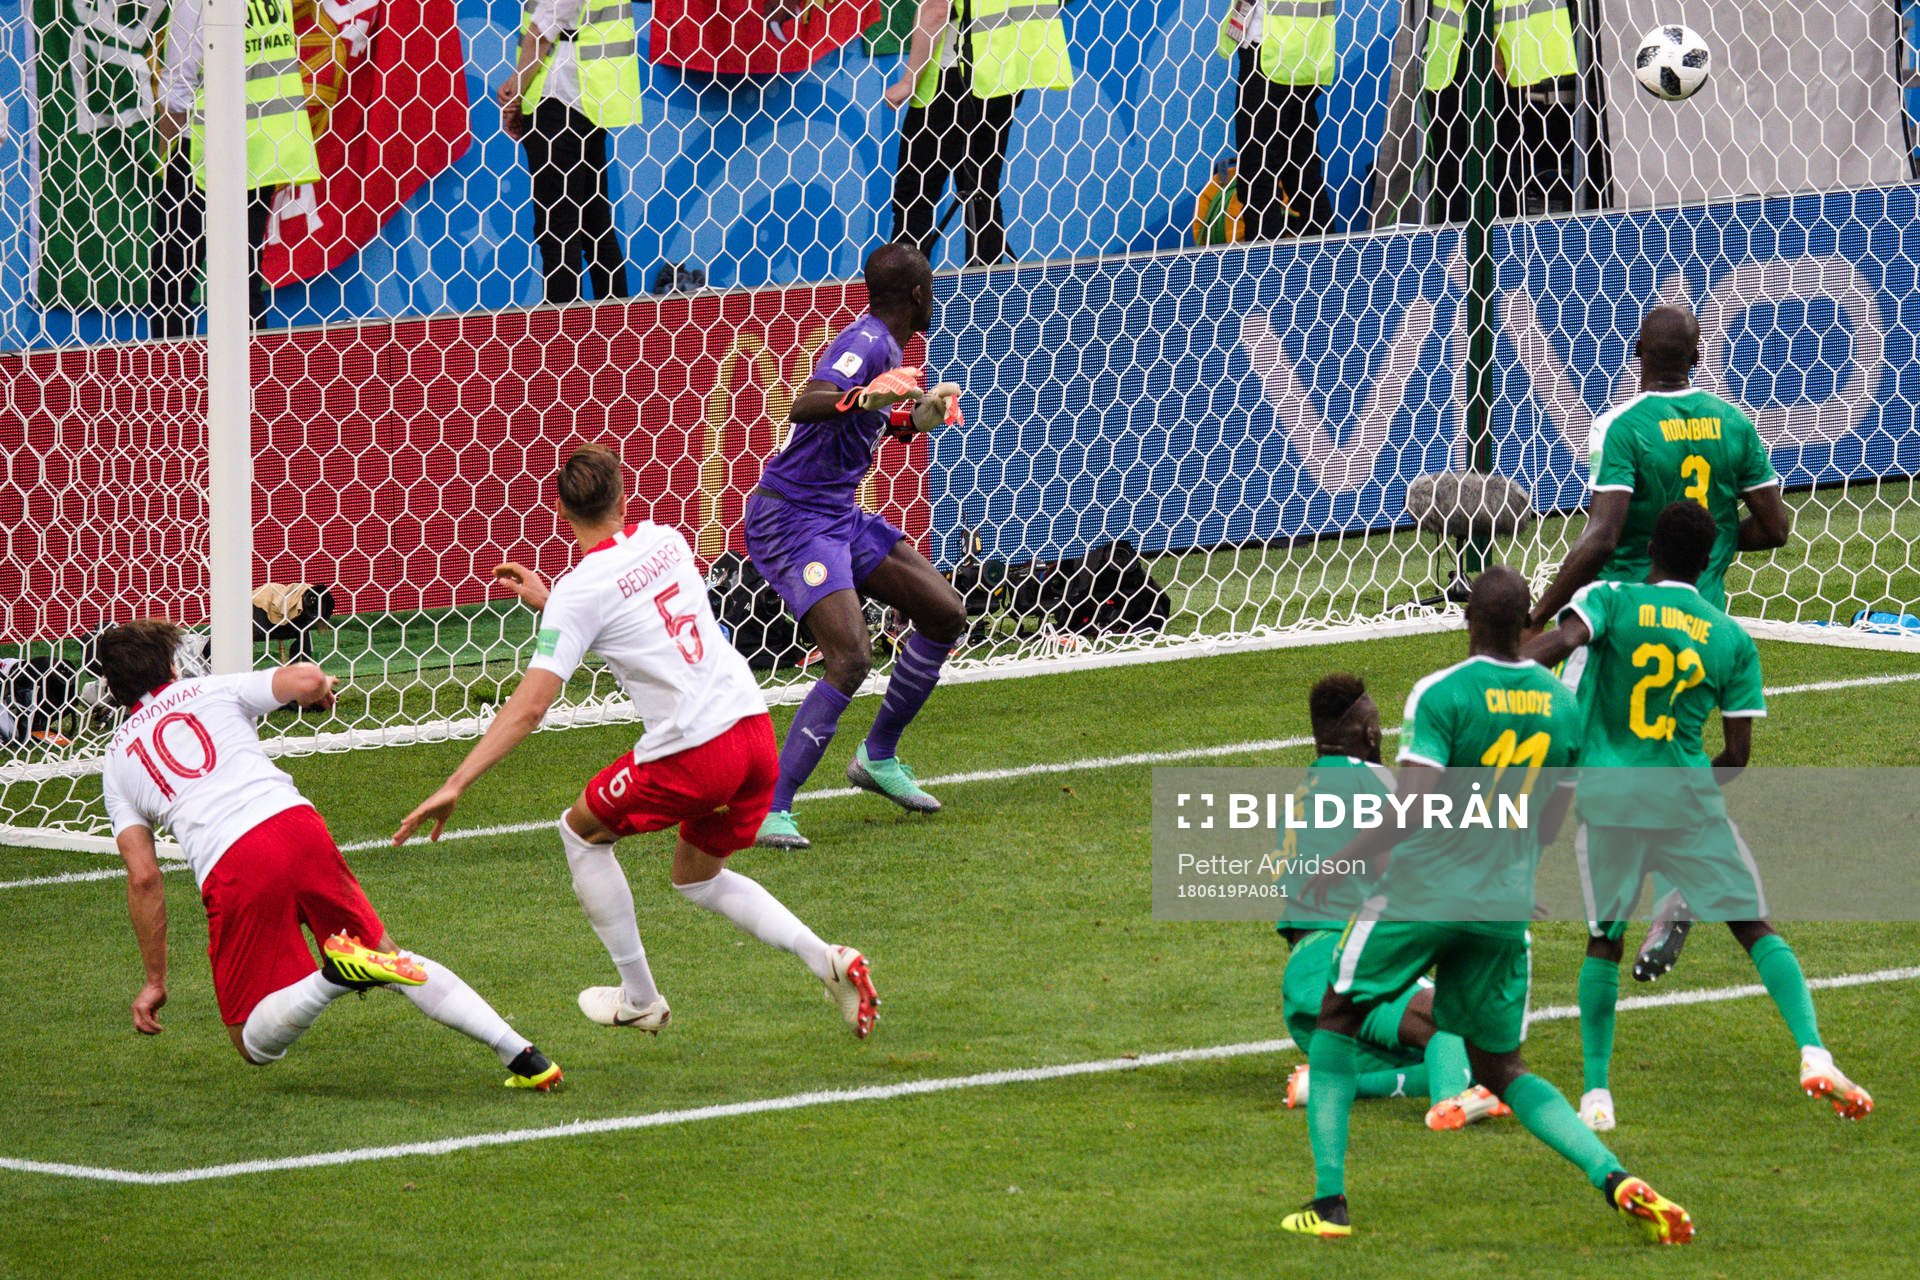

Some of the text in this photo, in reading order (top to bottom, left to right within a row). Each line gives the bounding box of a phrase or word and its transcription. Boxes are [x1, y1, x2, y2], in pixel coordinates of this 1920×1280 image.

[245, 33, 293, 53] STEWAR
[653, 581, 704, 665] 5
[1629, 642, 1706, 742] 22
[126, 711, 217, 801] 10
